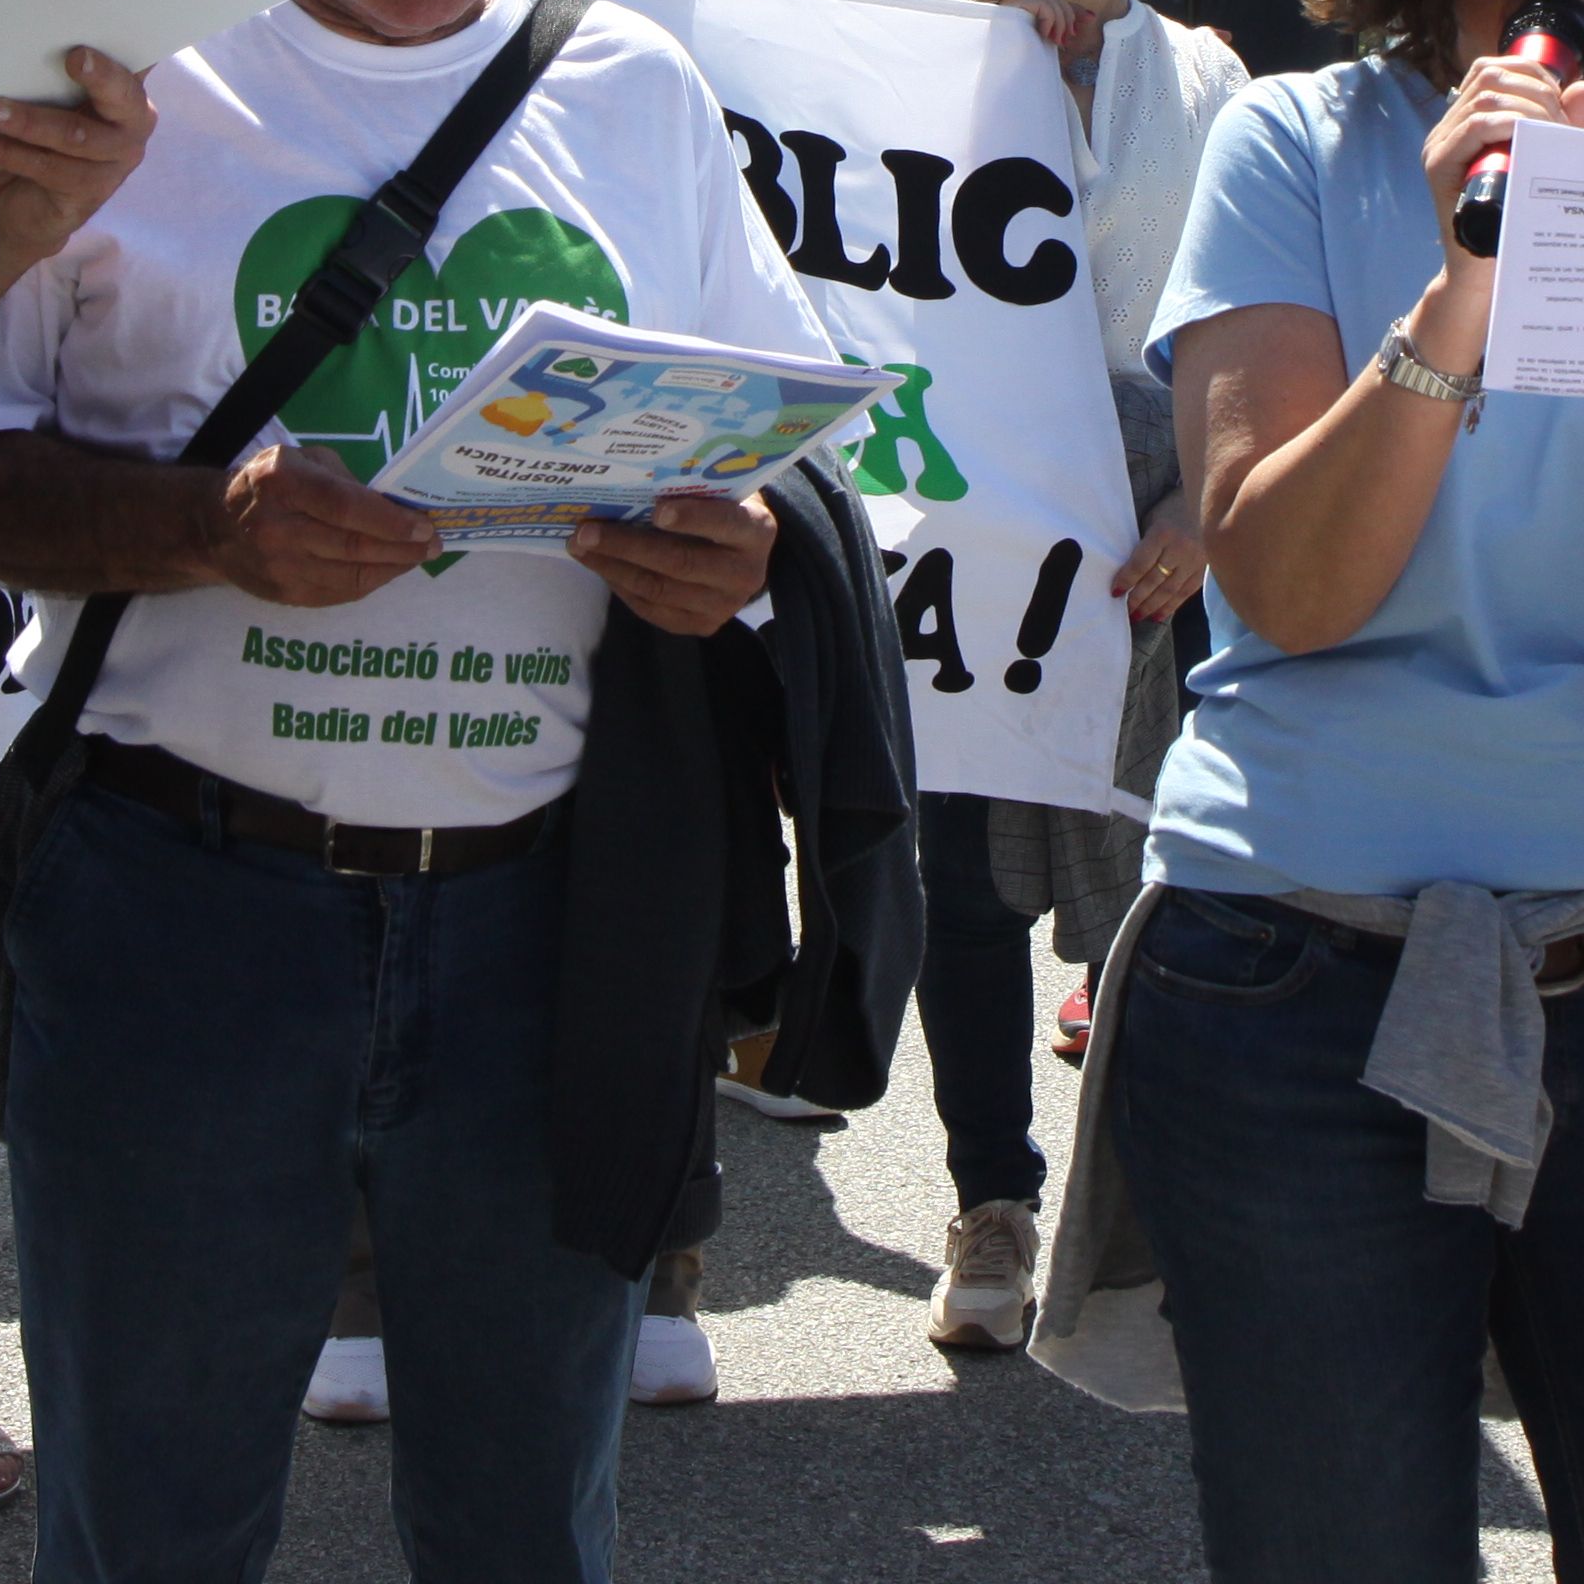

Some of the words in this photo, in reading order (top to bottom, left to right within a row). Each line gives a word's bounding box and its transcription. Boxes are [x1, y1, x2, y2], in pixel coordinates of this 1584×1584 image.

[716, 106, 1077, 306] BLIC
[392, 298, 468, 333] DEL
[454, 446, 526, 472] LLUCH
[475, 464, 574, 486] HOSPITAL
[526, 459, 611, 475] ERNEST
[242, 626, 439, 681] Associació
[450, 646, 494, 684] de
[505, 647, 572, 686] veïns
[272, 702, 370, 743] Badia
[381, 710, 438, 746] del
[448, 710, 542, 749] Vallès
